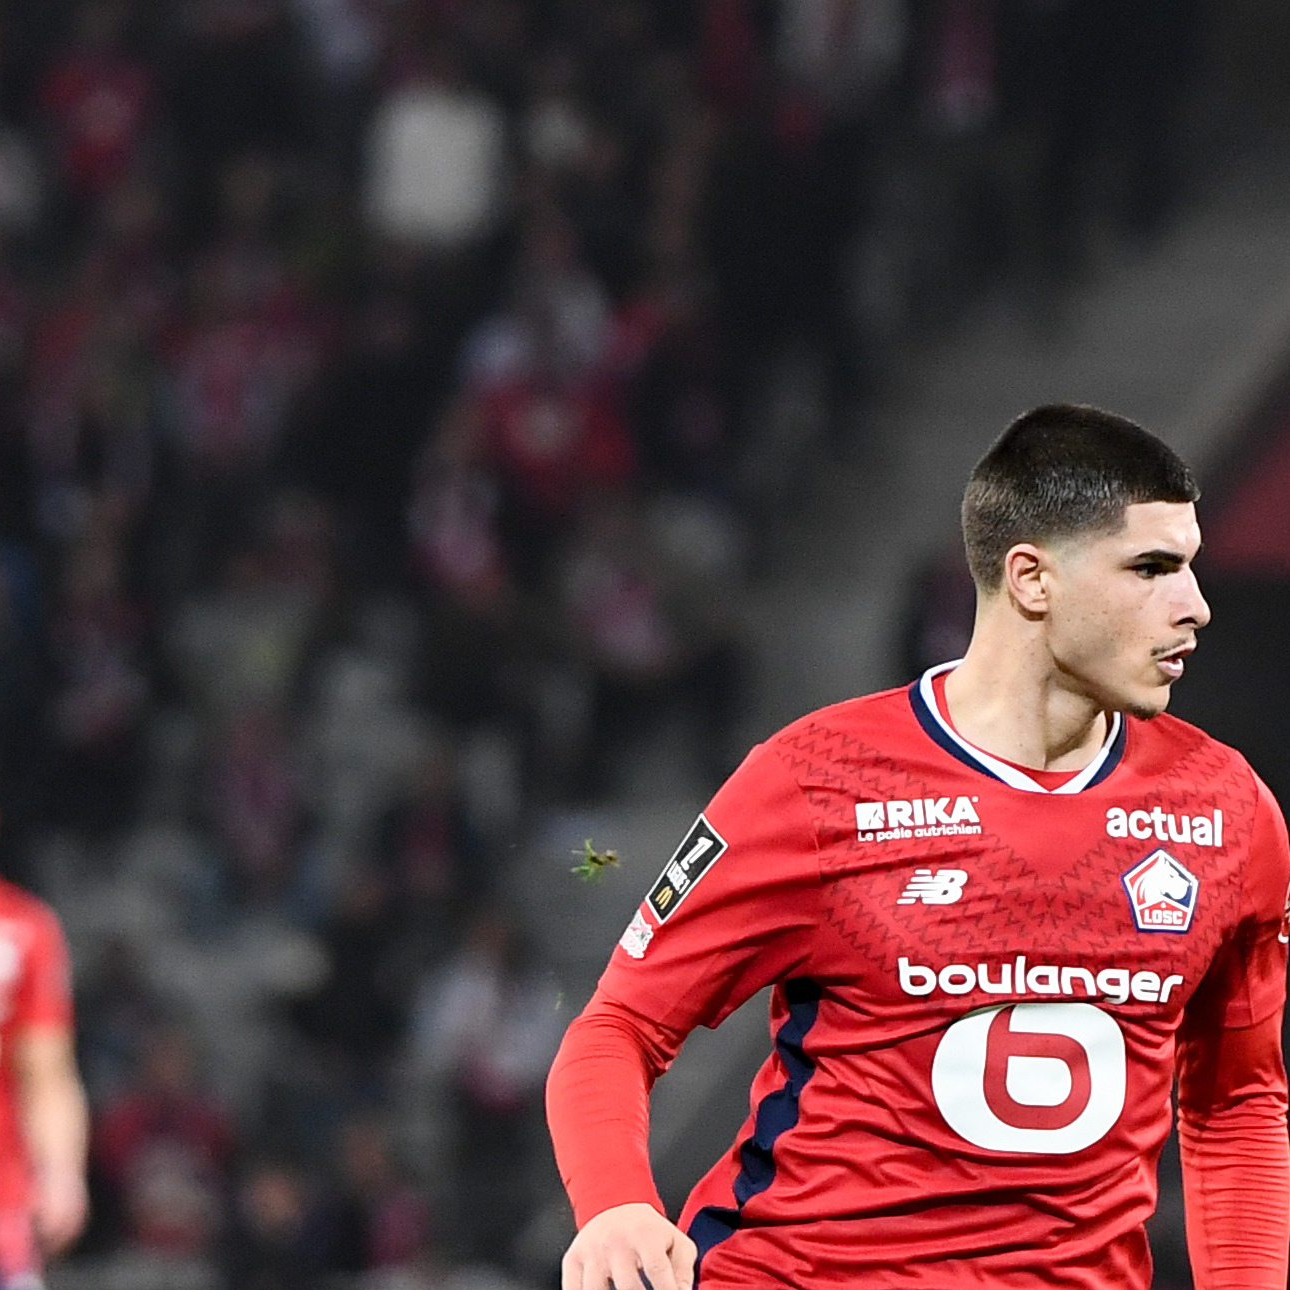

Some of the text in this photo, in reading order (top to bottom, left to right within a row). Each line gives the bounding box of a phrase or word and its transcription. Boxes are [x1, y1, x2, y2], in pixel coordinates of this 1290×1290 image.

[885, 796, 980, 828] RIKA
[1106, 806, 1223, 848] actual
[857, 831, 874, 842] Le
[914, 823, 982, 838] autrichien
[1143, 908, 1184, 926] LOSC
[898, 956, 1184, 1004] boulanger
